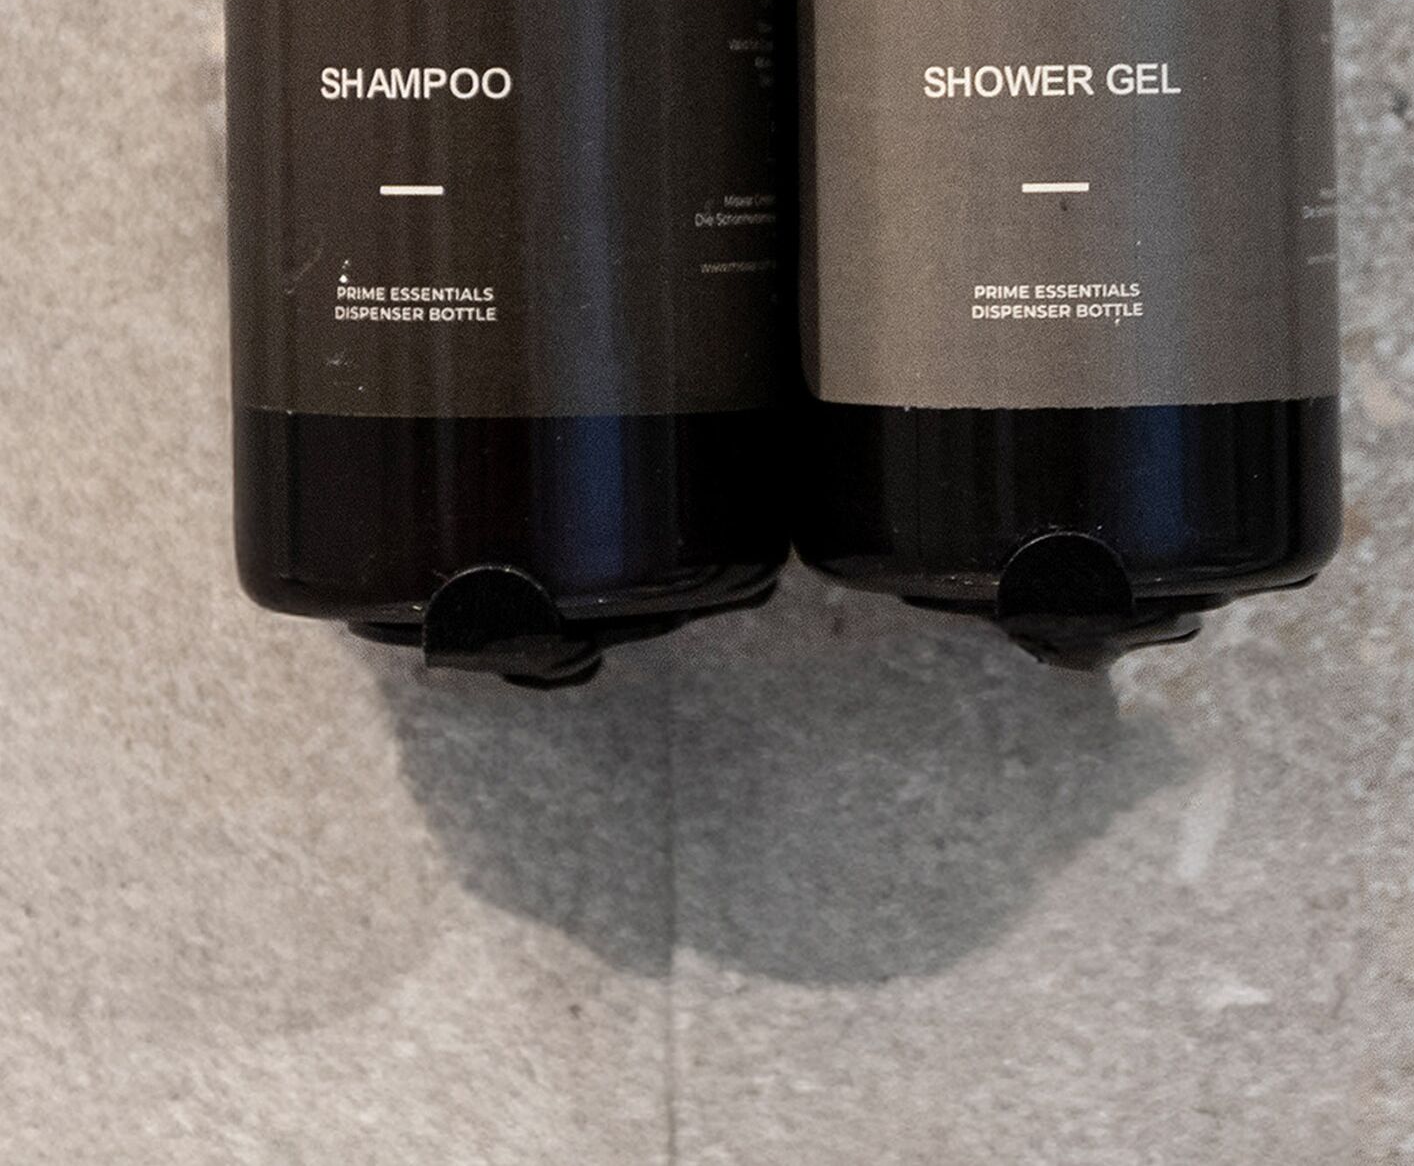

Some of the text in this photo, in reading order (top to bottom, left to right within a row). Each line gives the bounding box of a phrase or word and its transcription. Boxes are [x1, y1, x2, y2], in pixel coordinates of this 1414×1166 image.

[320, 67, 512, 100] SHAMPOO
[924, 63, 1182, 98] SHOWER GEL
[336, 286, 494, 302] PRIME ESSENTIALS
[974, 283, 1141, 300] PRIME ESSENTIALS
[334, 306, 497, 322] DISPENSER BOTTLE
[971, 302, 1144, 320] DISPENSER BOTTLE
